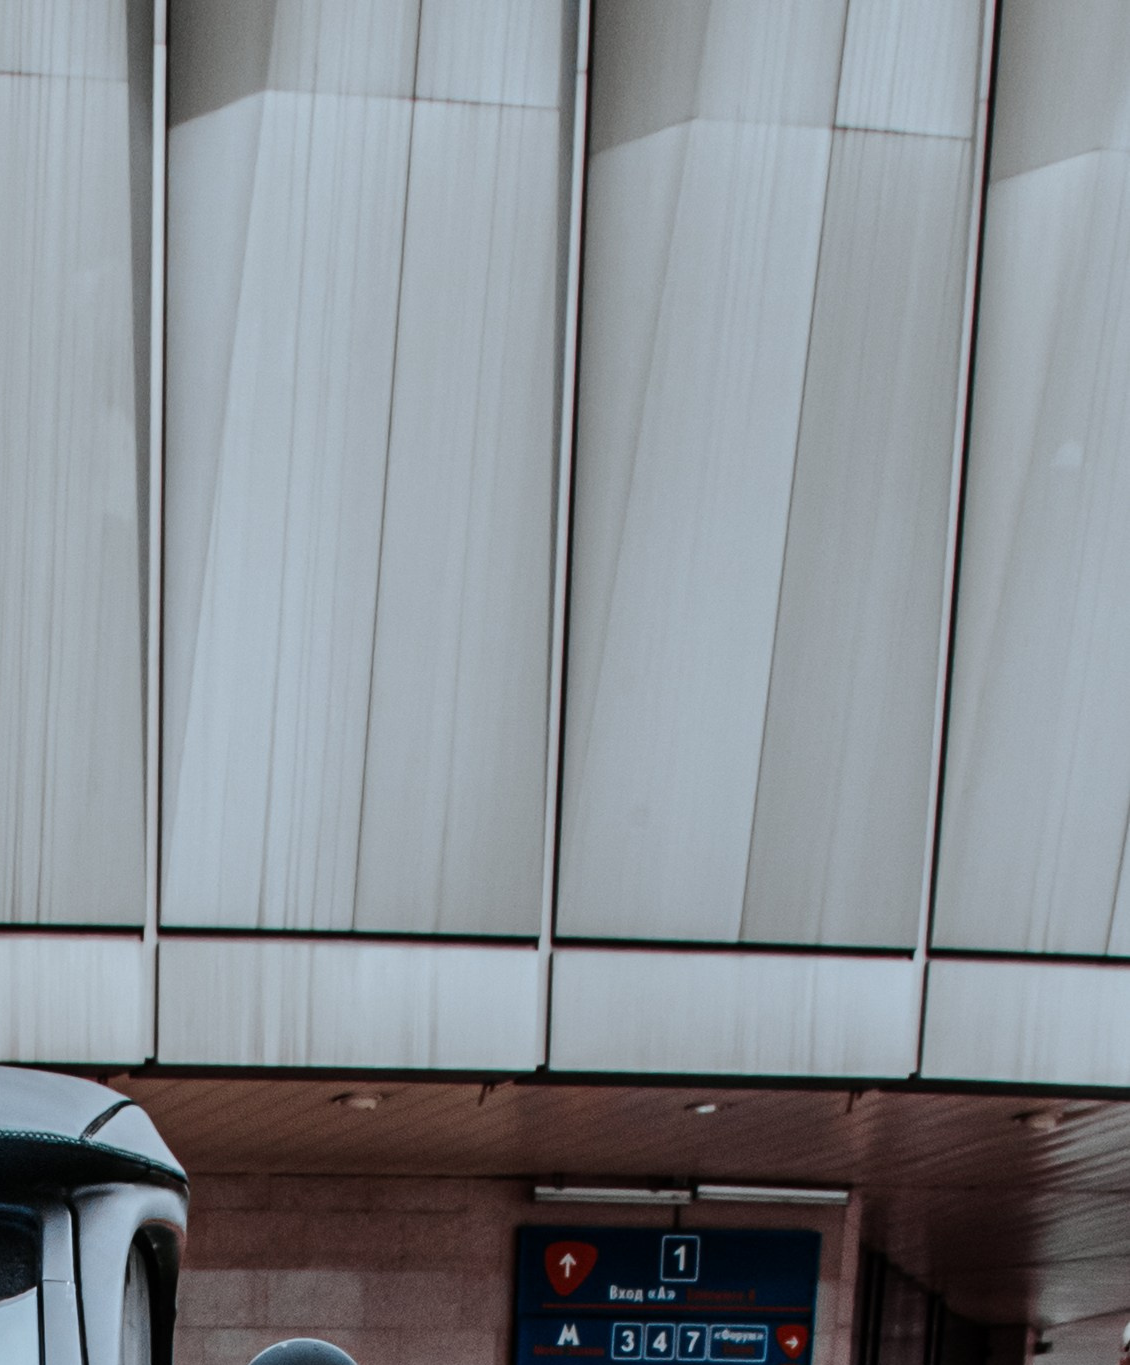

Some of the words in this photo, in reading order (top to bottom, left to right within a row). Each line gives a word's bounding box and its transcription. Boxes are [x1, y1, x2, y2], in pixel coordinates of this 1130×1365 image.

[673, 1244, 687, 1271] 1
[609, 1284, 644, 1302] Вход
[647, 1285, 676, 1301] «А»
[620, 1329, 635, 1352] 3
[652, 1330, 668, 1353] 4
[686, 1331, 701, 1353] 7
